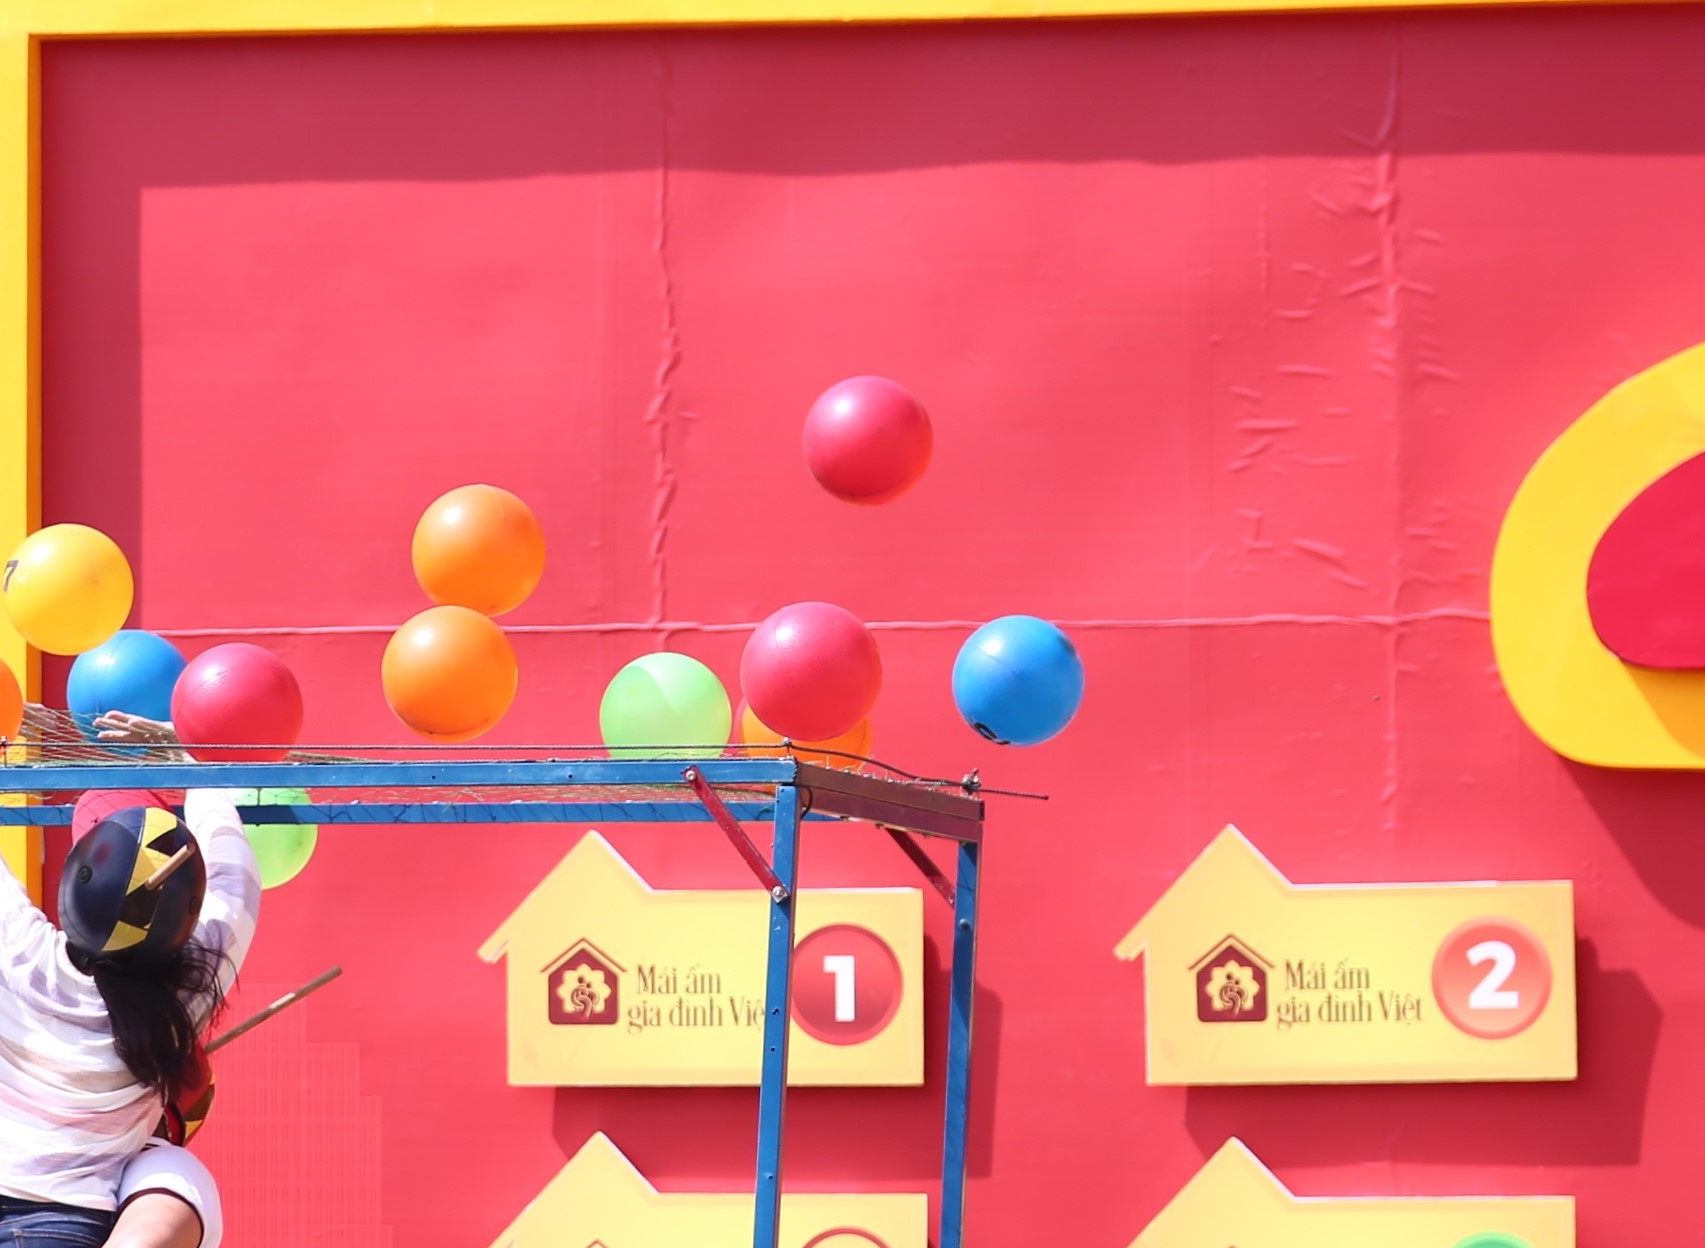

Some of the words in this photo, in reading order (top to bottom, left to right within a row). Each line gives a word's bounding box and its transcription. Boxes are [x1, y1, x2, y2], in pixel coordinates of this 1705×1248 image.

[637, 963, 678, 994] Mái
[685, 962, 722, 994] ấm
[823, 955, 856, 1023] 1
[1284, 958, 1326, 990] Mái
[1333, 956, 1371, 990] ấm
[1465, 940, 1519, 1010] 2
[627, 1000, 662, 1034] gia
[668, 996, 723, 1026] đình
[729, 996, 765, 1031] Việ
[1276, 994, 1311, 1030] gia
[1318, 989, 1373, 1023] đình
[1379, 990, 1424, 1026] Việt
